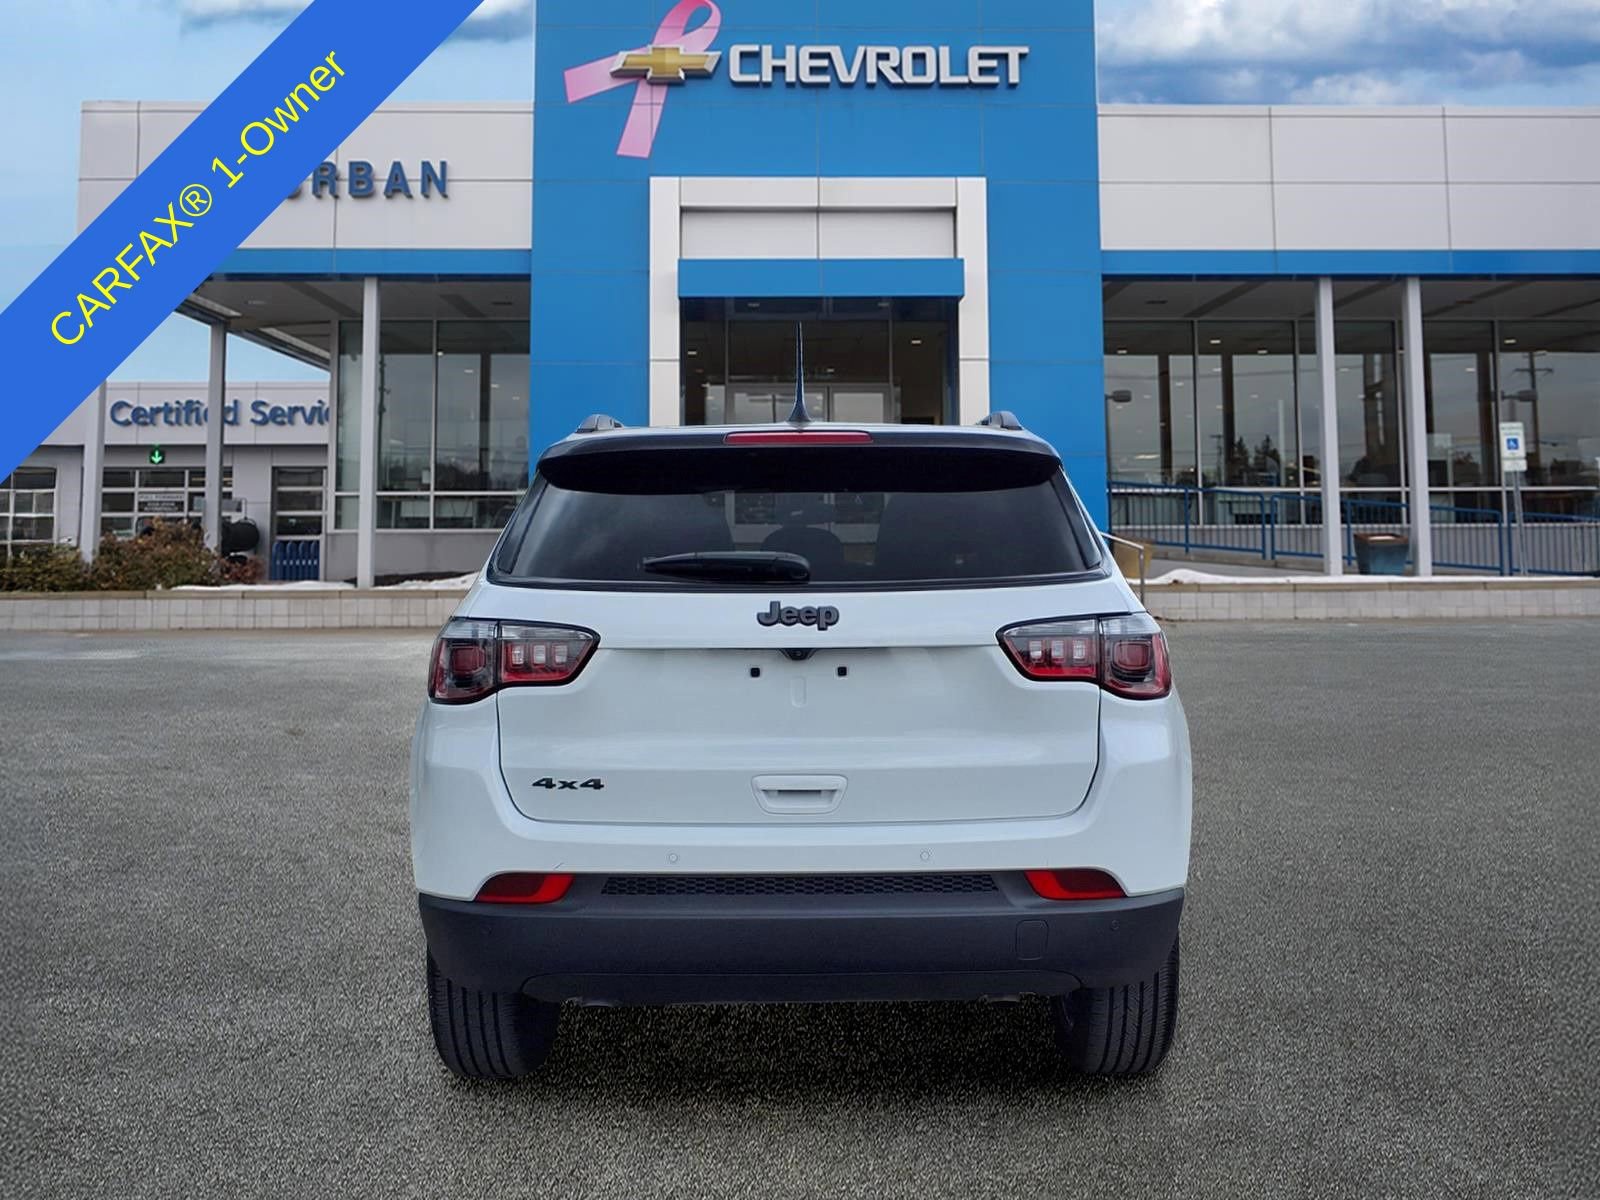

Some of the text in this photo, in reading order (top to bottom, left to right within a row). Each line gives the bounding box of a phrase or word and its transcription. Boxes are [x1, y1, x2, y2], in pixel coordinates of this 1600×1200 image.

[729, 44, 1029, 86] CHEVROLET
[287, 160, 448, 199] RBAN
[110, 399, 240, 427] Certifid
[756, 600, 840, 631] Jeep
[532, 777, 605, 790] 4x4
